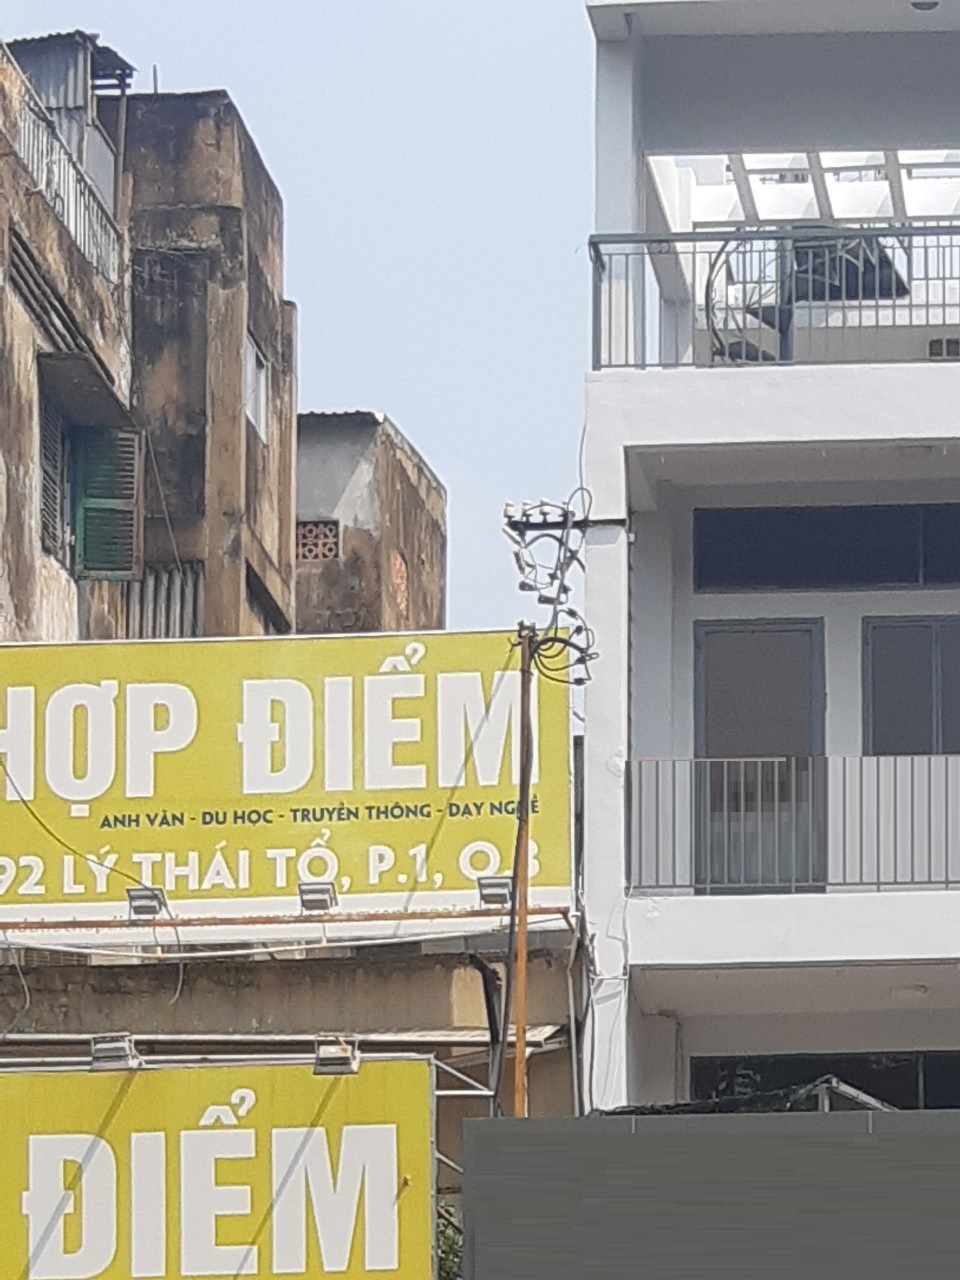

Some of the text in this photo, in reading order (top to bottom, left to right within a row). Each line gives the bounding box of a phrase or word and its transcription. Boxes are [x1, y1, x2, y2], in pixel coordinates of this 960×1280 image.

[237, 642, 540, 795] ĐIỂM
[100, 813, 141, 830] ANH
[146, 808, 185, 828] VĂN
[202, 810, 227, 827] DU
[233, 808, 274, 828] HỌC
[365, 800, 432, 821] THÔNG
[448, 801, 485, 819] DẠY
[489, 794, 540, 816] NGỀ
[62, 845, 119, 894] LÝ
[131, 839, 250, 893] THÁI
[368, 843, 444, 890] P.1,
[22, 1087, 400, 1280] ĐIỂM
